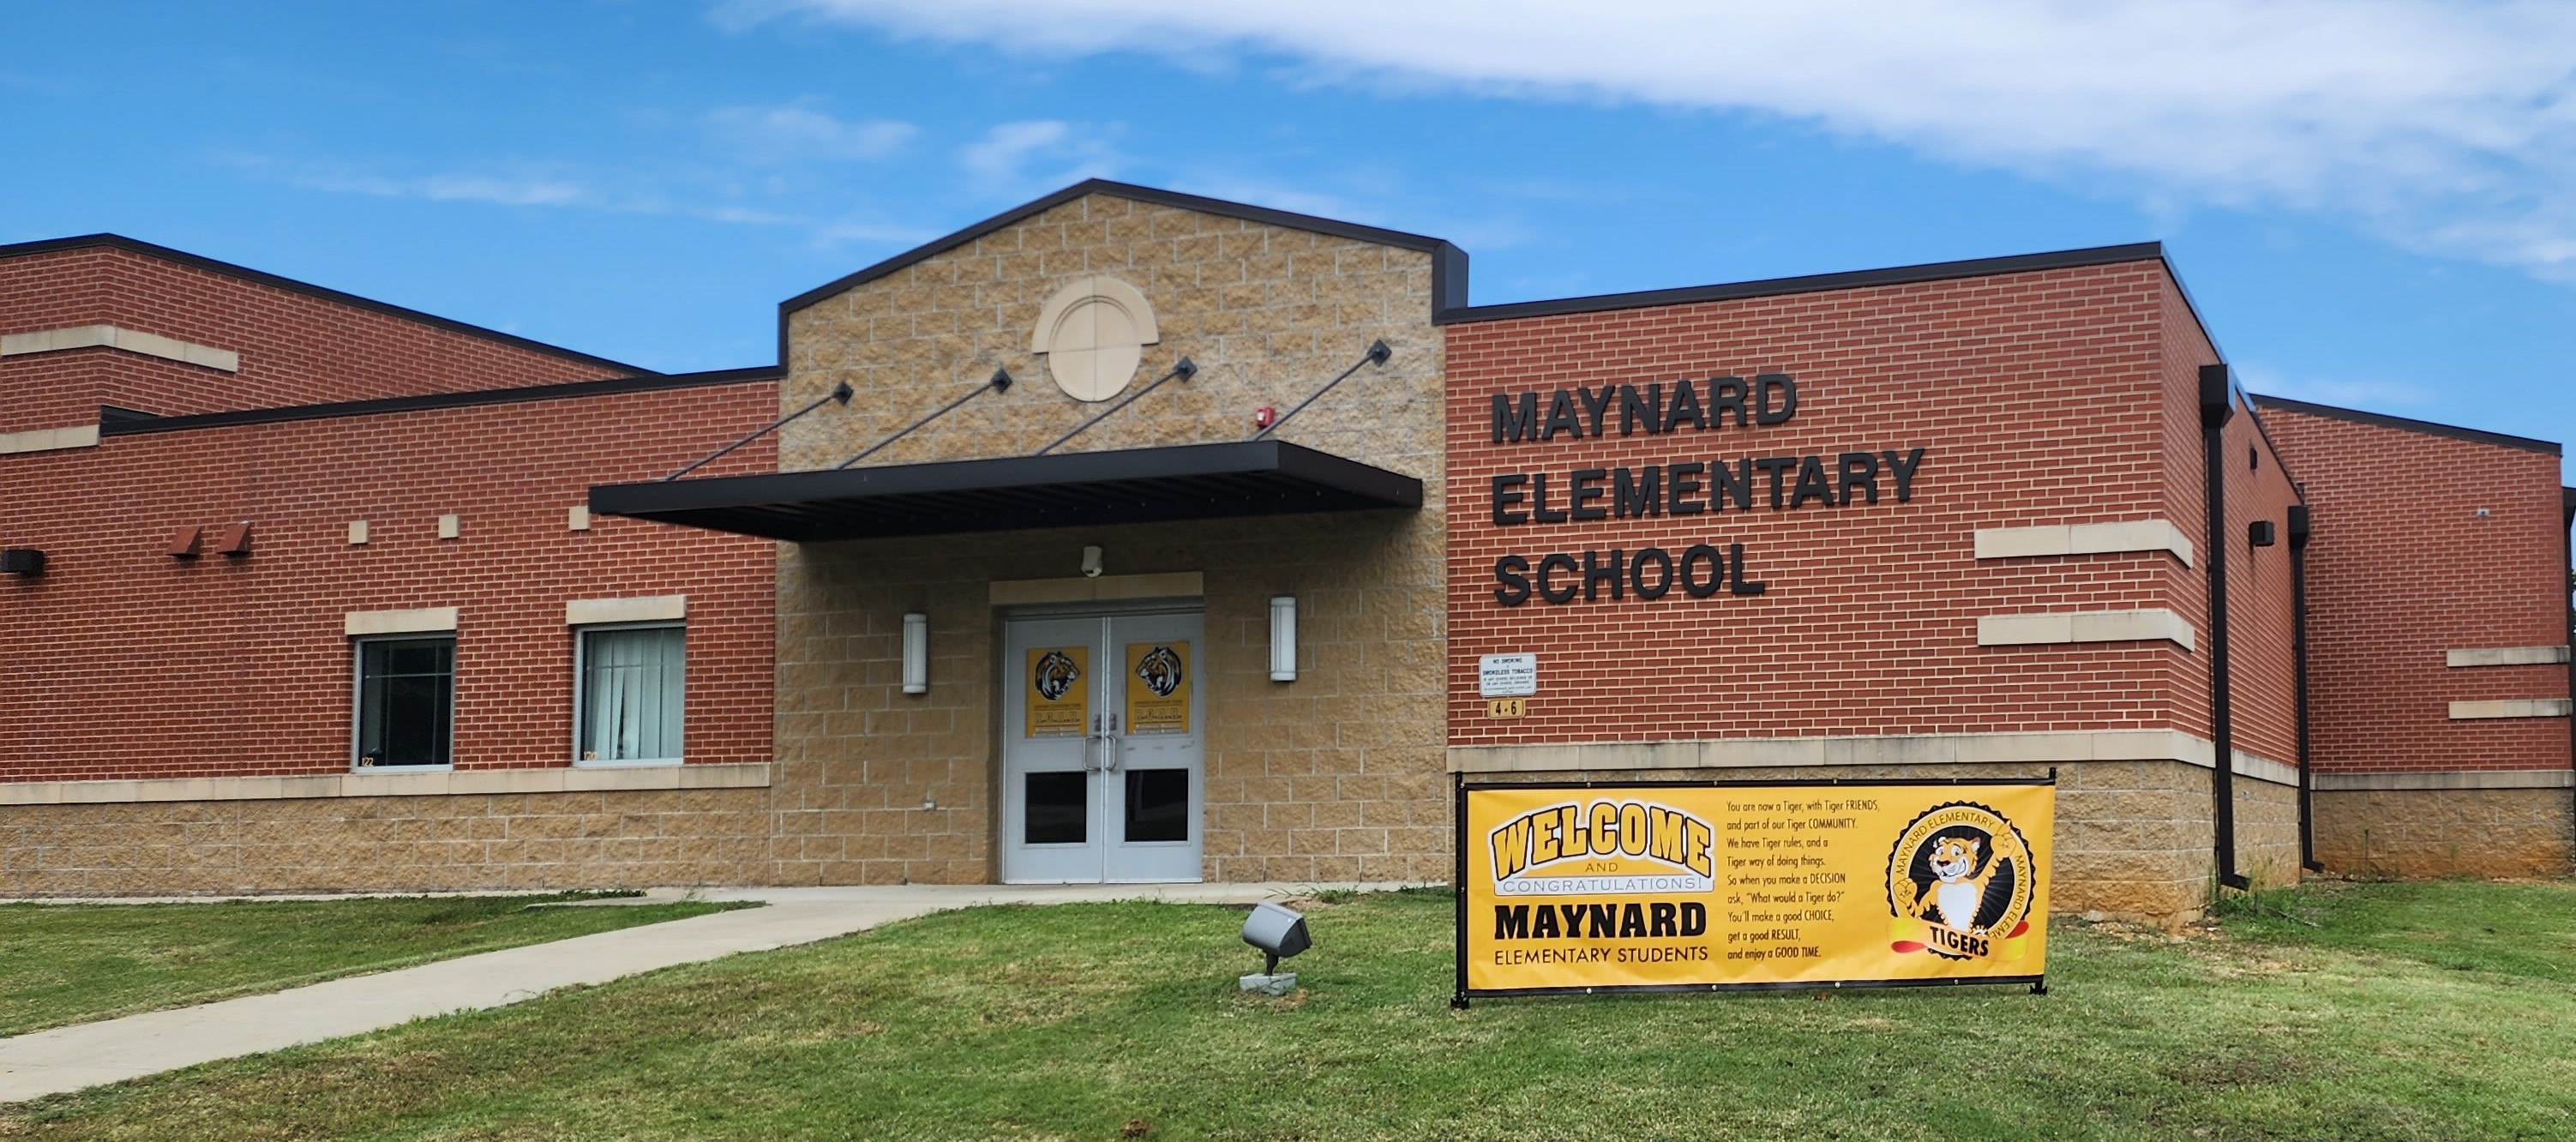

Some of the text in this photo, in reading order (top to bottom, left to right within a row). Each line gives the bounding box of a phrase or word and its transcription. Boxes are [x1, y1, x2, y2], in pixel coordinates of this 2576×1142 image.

[1492, 373, 1797, 443] MAYNARD
[1492, 448, 1925, 526] ELEMENTARY
[1493, 544, 1765, 607] SCHOOL
[362, 757, 374, 767] 122
[1726, 801, 1740, 812] You
[1743, 803, 1756, 812] are
[1783, 800, 1804, 814] Tiger,
[1806, 800, 1822, 811] with
[1824, 800, 1844, 814] Tiger
[1846, 799, 1880, 812] FRIENDS,
[1726, 819, 1742, 830] and
[1744, 820, 1760, 832] part
[1762, 818, 1770, 830] of
[1787, 819, 1806, 832] Tiger
[1808, 818, 1858, 829] COMMUNITY.
[1491, 801, 1712, 881] WELCOME
[1726, 838, 1738, 848] We
[1740, 837, 1760, 848] have
[1762, 837, 1781, 850] Tiger
[1783, 836, 1804, 849] rules,
[1806, 836, 1822, 848] and
[1895, 811, 1996, 875] MAYNARD ELEMENTARY
[1585, 863, 1618, 873] AND
[1726, 855, 1826, 869] Tiger way of doing things.
[1503, 877, 1702, 893] CONGRATULATIONS!
[1727, 875, 1737, 886] So
[1739, 874, 1760, 885] when
[1762, 876, 1776, 887] you
[1779, 873, 1800, 884] make
[1810, 873, 1846, 884] DECISION
[2013, 855, 2027, 911] MAYNARD
[1727, 892, 1744, 905] ask,
[1773, 891, 1796, 903] would
[1805, 892, 1824, 905] Tiger
[1494, 902, 1707, 940] MAYNARD
[1727, 911, 1750, 923] You'll
[1751, 911, 1774, 922] make
[1783, 910, 1803, 924] good
[1804, 910, 1834, 922] CHOICE,
[1727, 932, 1740, 944] get
[1750, 929, 1769, 943] good
[1771, 929, 1801, 941] RESULT,
[1929, 925, 1989, 957] TIGERS
[1495, 946, 1708, 965] ELEMENTARY STUDENTS
[1727, 946, 1822, 961] and enjoy a GOOD TIME.
